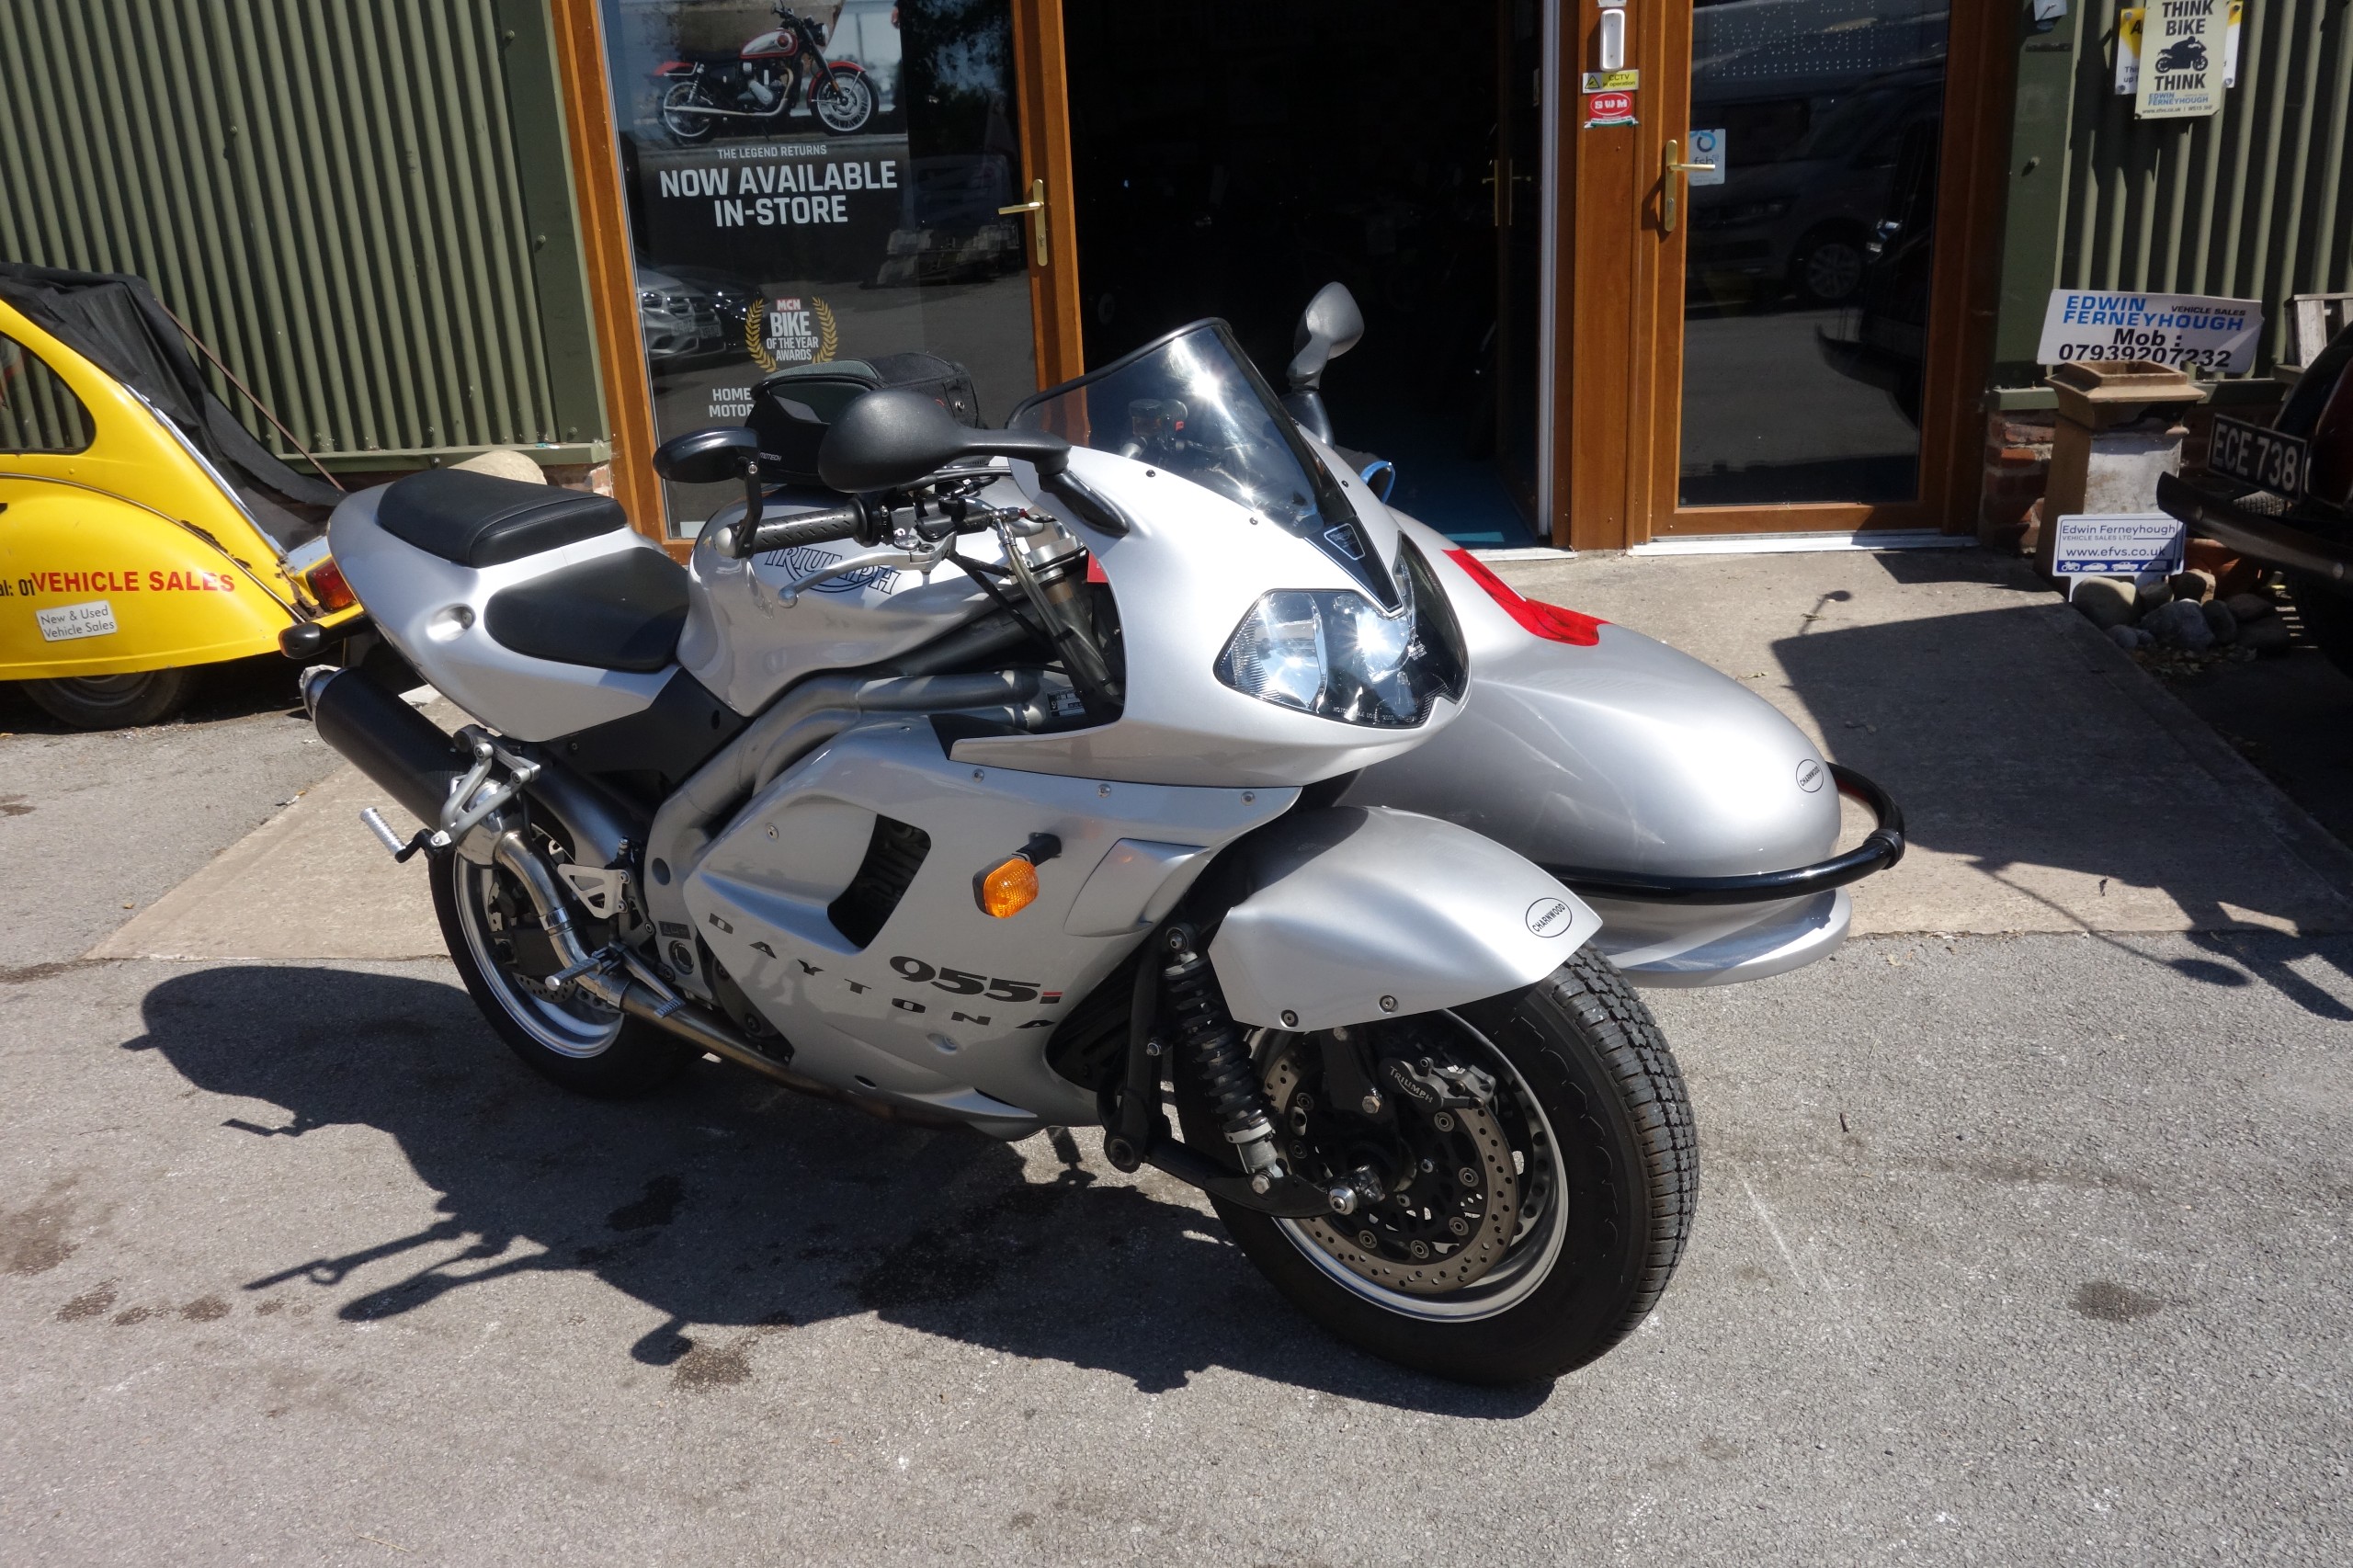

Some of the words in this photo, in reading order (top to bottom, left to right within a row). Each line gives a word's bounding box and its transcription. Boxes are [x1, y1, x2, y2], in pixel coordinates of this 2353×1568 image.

[2162, 0, 2213, 17] THINK
[2165, 18, 2206, 36] BIKE
[2154, 73, 2206, 91] THINK
[1595, 99, 1628, 109] SWM
[2148, 97, 2208, 106] FERNEYHOUGH
[717, 148, 737, 159] THE
[739, 147, 778, 158] LEGEND
[781, 144, 827, 157] RETURNS
[660, 168, 729, 198] NOW
[739, 160, 897, 195] AVAILABLE
[714, 195, 848, 227] IN-STORE
[777, 299, 801, 311] MCN
[2066, 295, 2146, 312] EDWIN
[2171, 305, 2211, 314] VEHICLE
[2213, 308, 2245, 316] SALES
[769, 312, 812, 337] BIKE
[2063, 311, 2244, 331] FERNEYHOUGH
[766, 337, 777, 349] OF
[778, 337, 795, 349] THE
[795, 336, 819, 348] YEAR
[2112, 328, 2165, 346] Mob
[776, 348, 813, 361] AWARDS
[712, 388, 752, 402] HOME
[2211, 422, 2253, 476] ECE
[2256, 436, 2298, 492] 738
[2062, 525, 2096, 534] Edwin
[2100, 524, 2176, 536] Ferneyhough
[2065, 546, 2165, 557] www.efvs.co.uk
[30, 572, 140, 593] VEHICLE
[149, 571, 235, 593] SALES
[40, 613, 65, 629] New
[69, 610, 78, 622] &
[80, 605, 108, 620] Used
[43, 622, 83, 639] Vehicle
[86, 619, 115, 633] Sales
[1532, 903, 1565, 932] CHARNWOOD
[709, 912, 1056, 1029] DAYTONA
[889, 955, 1063, 1005] 955i
[1390, 1065, 1434, 1104] TRIUMPH
